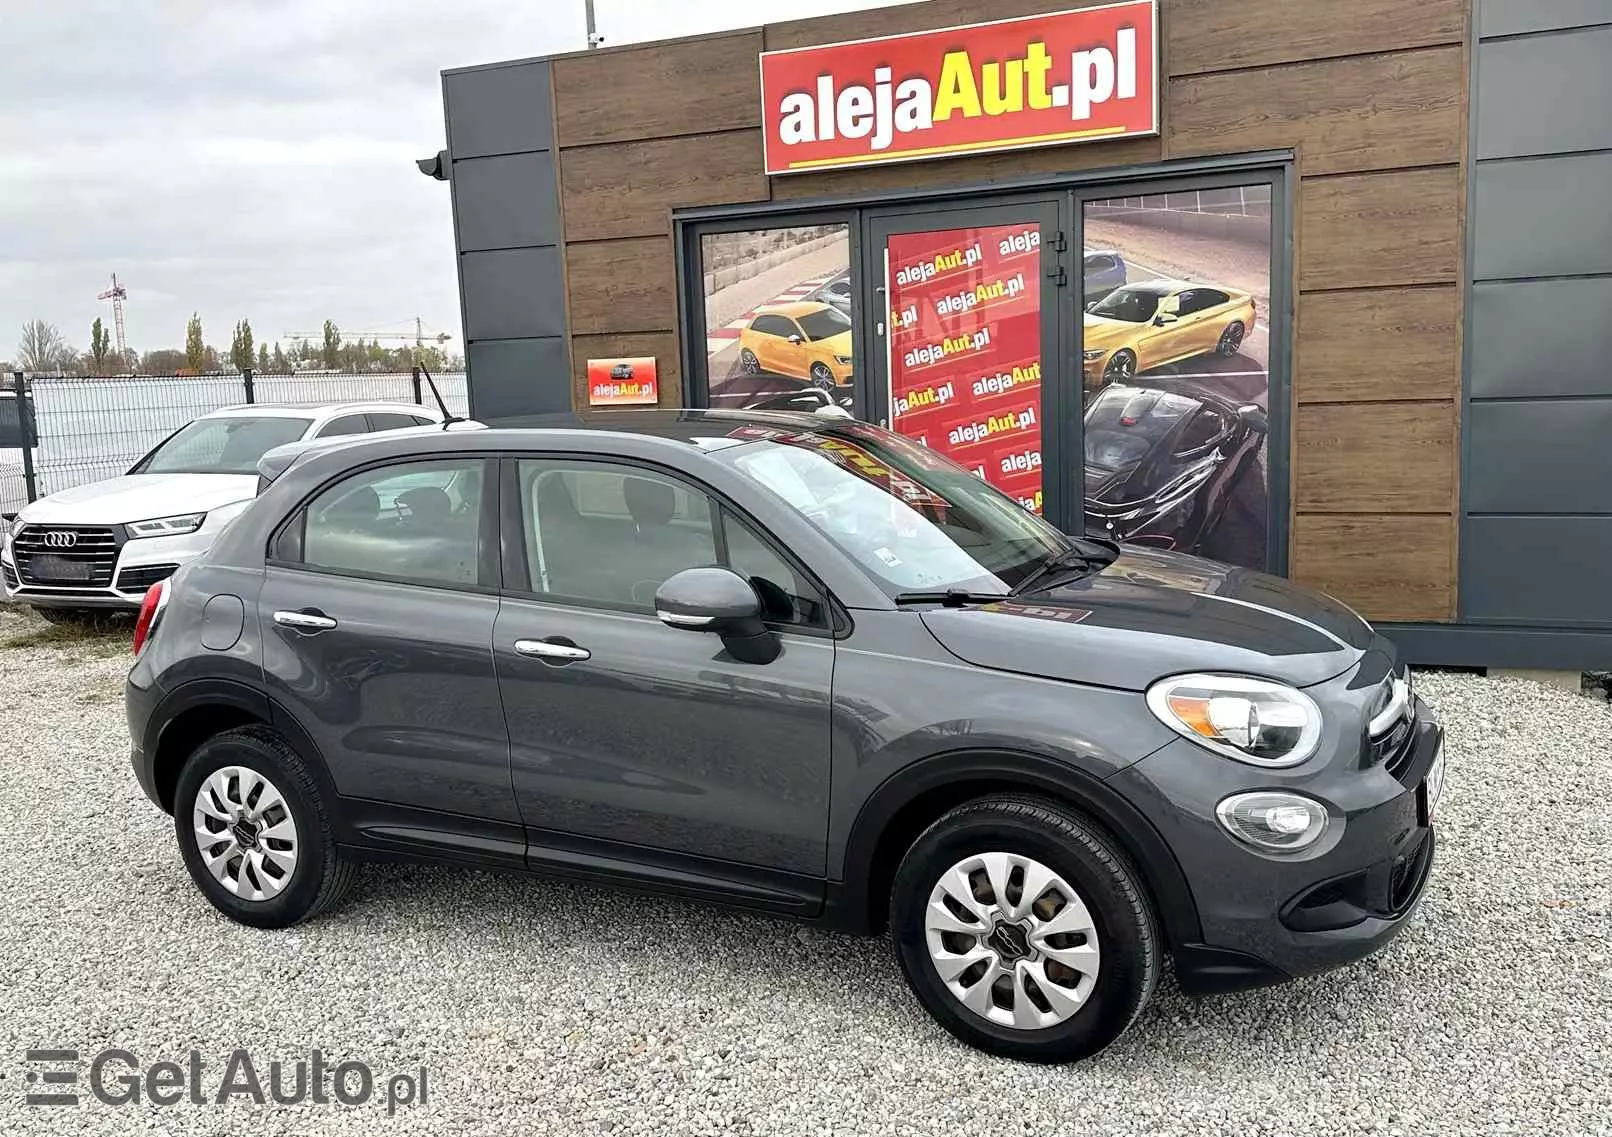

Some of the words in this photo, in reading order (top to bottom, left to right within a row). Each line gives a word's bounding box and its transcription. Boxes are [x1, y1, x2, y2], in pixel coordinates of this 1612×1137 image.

[778, 27, 1137, 151] alejaAut.pl
[999, 230, 1041, 256] aleja
[896, 243, 983, 285] alejaAut.pl
[936, 273, 1025, 312] alejaAut.pl
[904, 327, 991, 367] alejaAut.pl
[593, 382, 653, 398] alejaAut.pl
[948, 407, 1037, 445] alejaAut.pl
[1001, 450, 1042, 473] aleja
